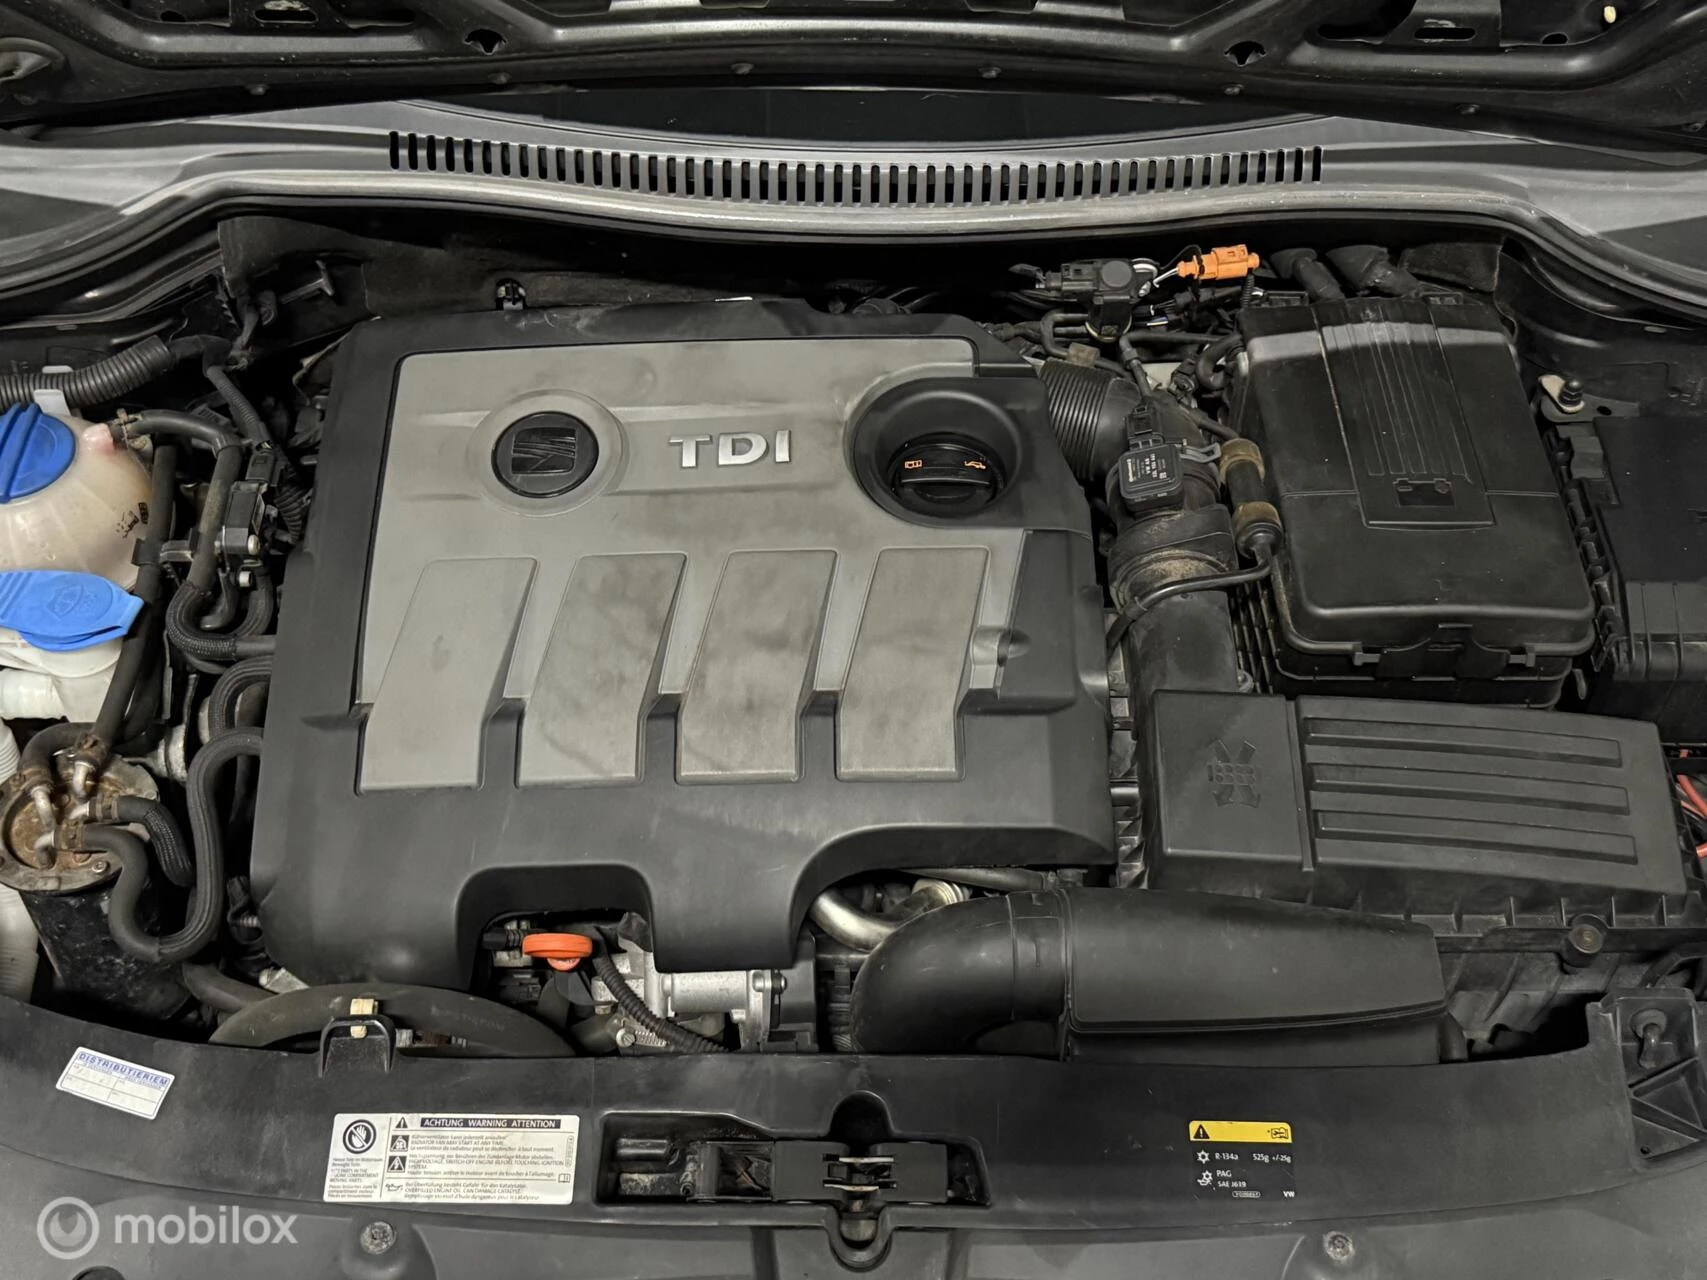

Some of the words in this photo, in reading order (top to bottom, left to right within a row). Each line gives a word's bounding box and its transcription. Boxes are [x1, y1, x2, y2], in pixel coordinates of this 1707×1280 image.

[669, 429, 791, 468] TDI
[423, 1118, 464, 1127] ACHTUNG
[467, 1119, 508, 1128] WARNING
[511, 1119, 556, 1128] ATTENTION
[1252, 1153, 1269, 1163] 525g
